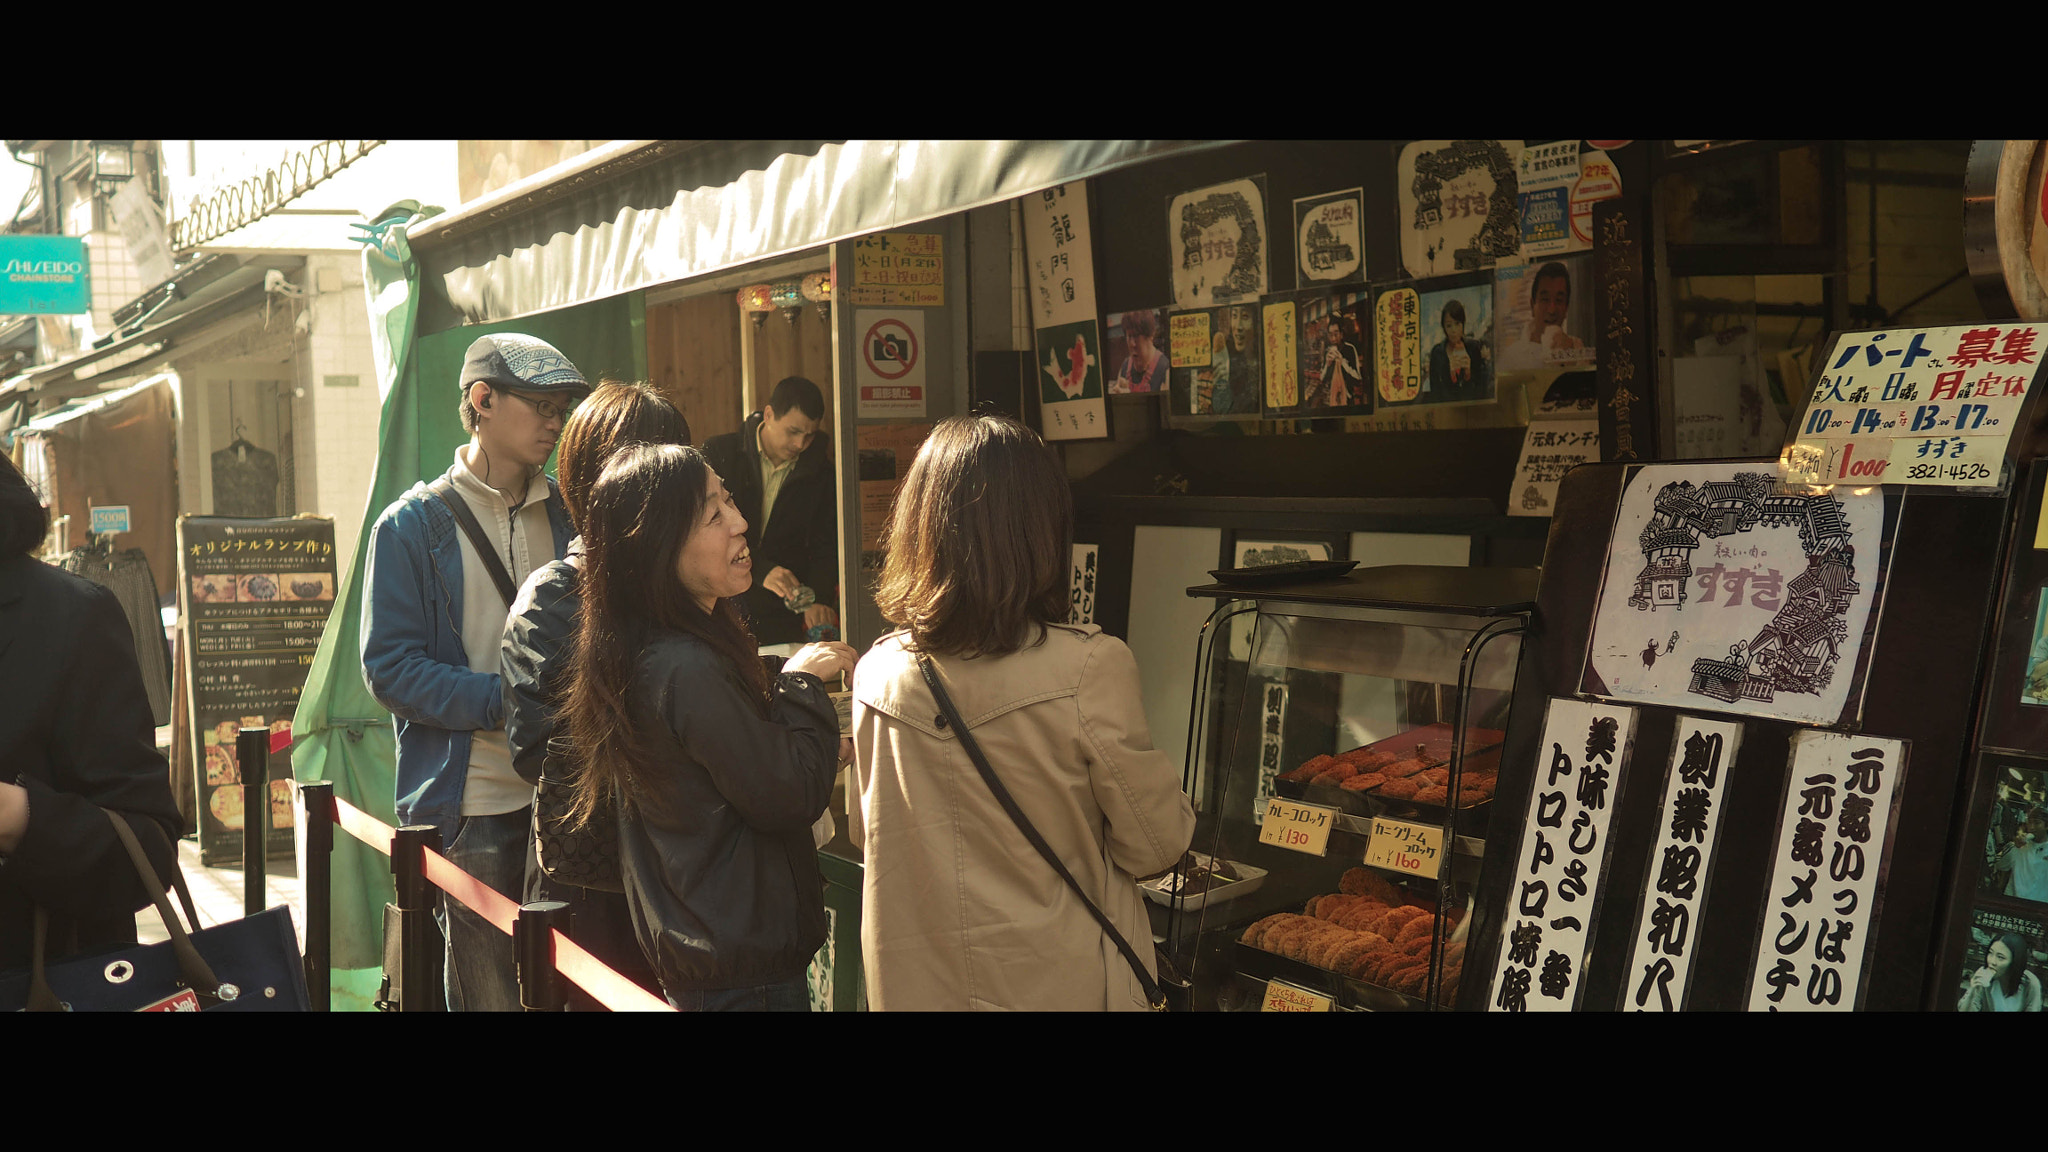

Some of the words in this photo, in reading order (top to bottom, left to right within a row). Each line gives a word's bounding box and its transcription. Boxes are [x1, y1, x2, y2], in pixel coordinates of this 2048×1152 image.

[1, 259, 82, 273] SHISEIDO
[10, 274, 74, 282] CHAINSTORE
[1403, 291, 1418, 388] 東京メトロ
[872, 387, 911, 399] 撮影禁止
[1916, 436, 1968, 459] すずき
[1906, 463, 1991, 480] 3821-4526
[190, 538, 332, 556] オリジナルランプ作り
[1695, 562, 1784, 612] すずき
[1268, 804, 1328, 827] カレーコロッケ
[1277, 826, 1309, 846] ¥130
[1375, 822, 1427, 846] カニクリーム
[1386, 849, 1421, 870] ¥160
[1404, 844, 1437, 859] コロッケ
[1539, 716, 1619, 1001] 美味しさ一番
